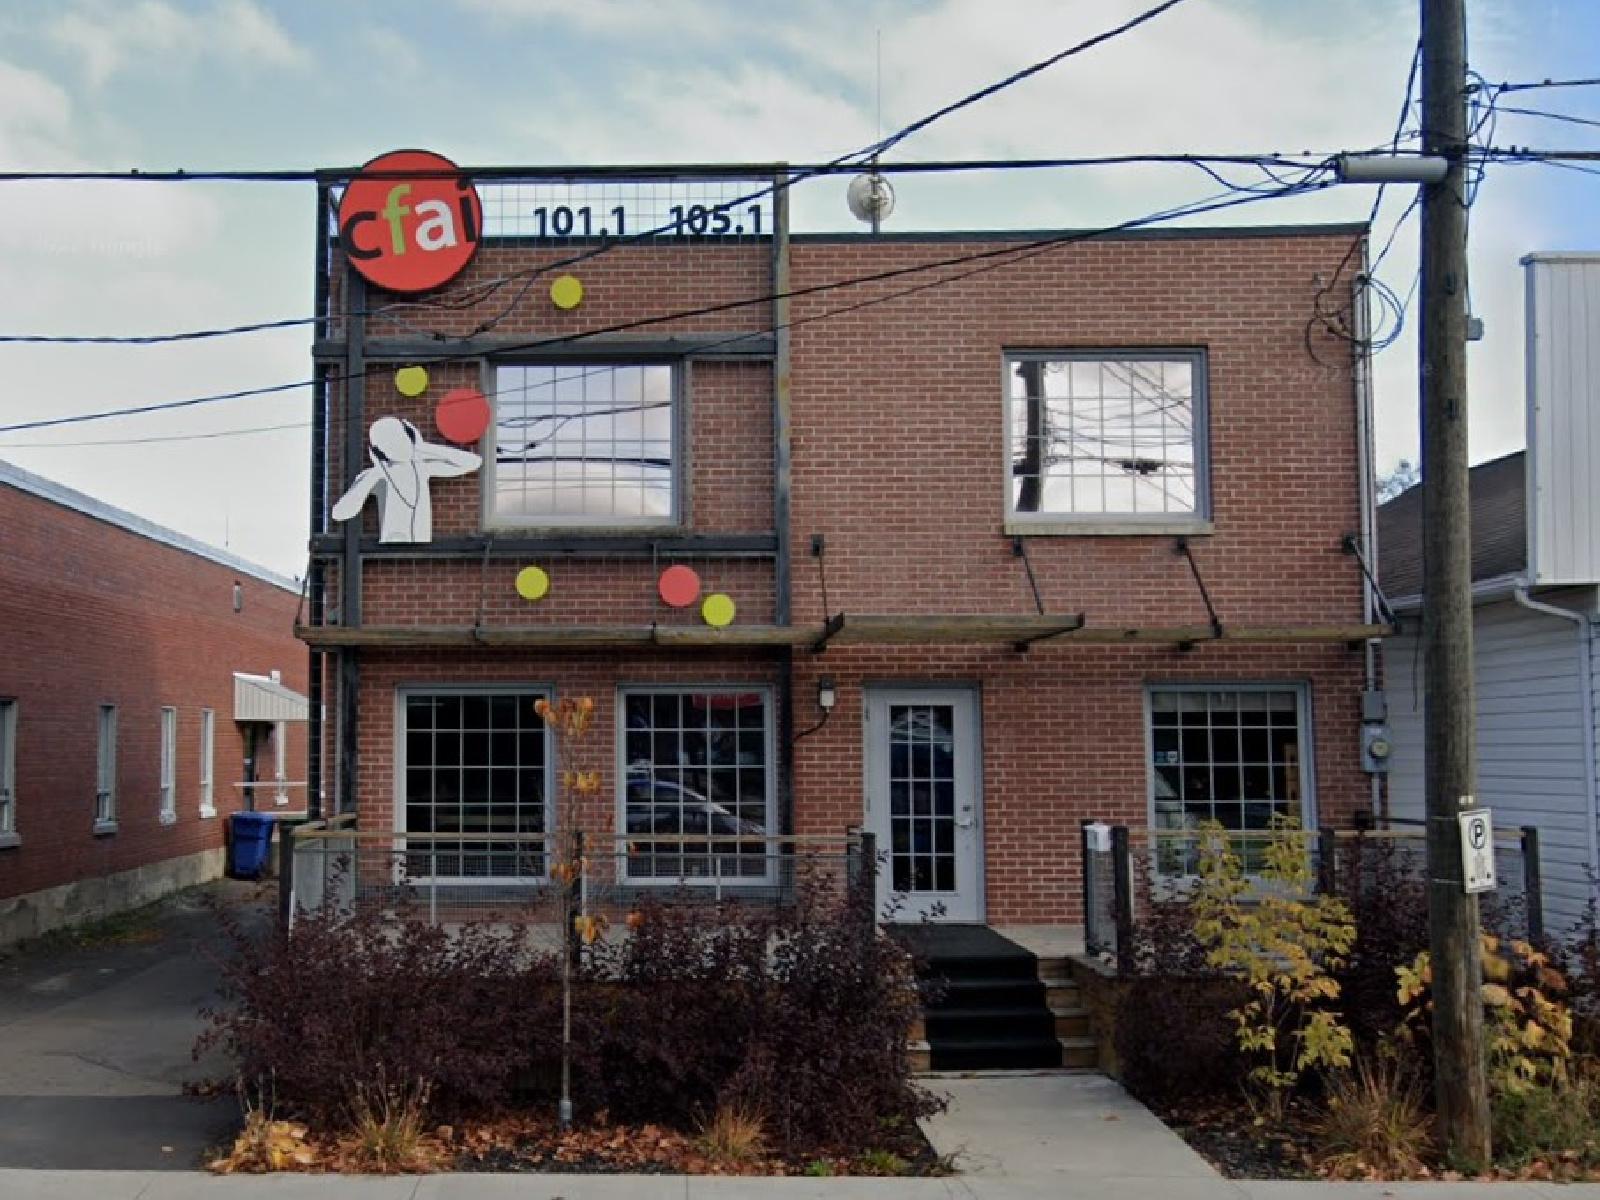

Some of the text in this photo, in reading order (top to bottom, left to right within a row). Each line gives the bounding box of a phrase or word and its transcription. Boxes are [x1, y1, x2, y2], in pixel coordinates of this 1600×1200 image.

[341, 177, 477, 260] cfai
[533, 204, 761, 238] 101.1 105.1
